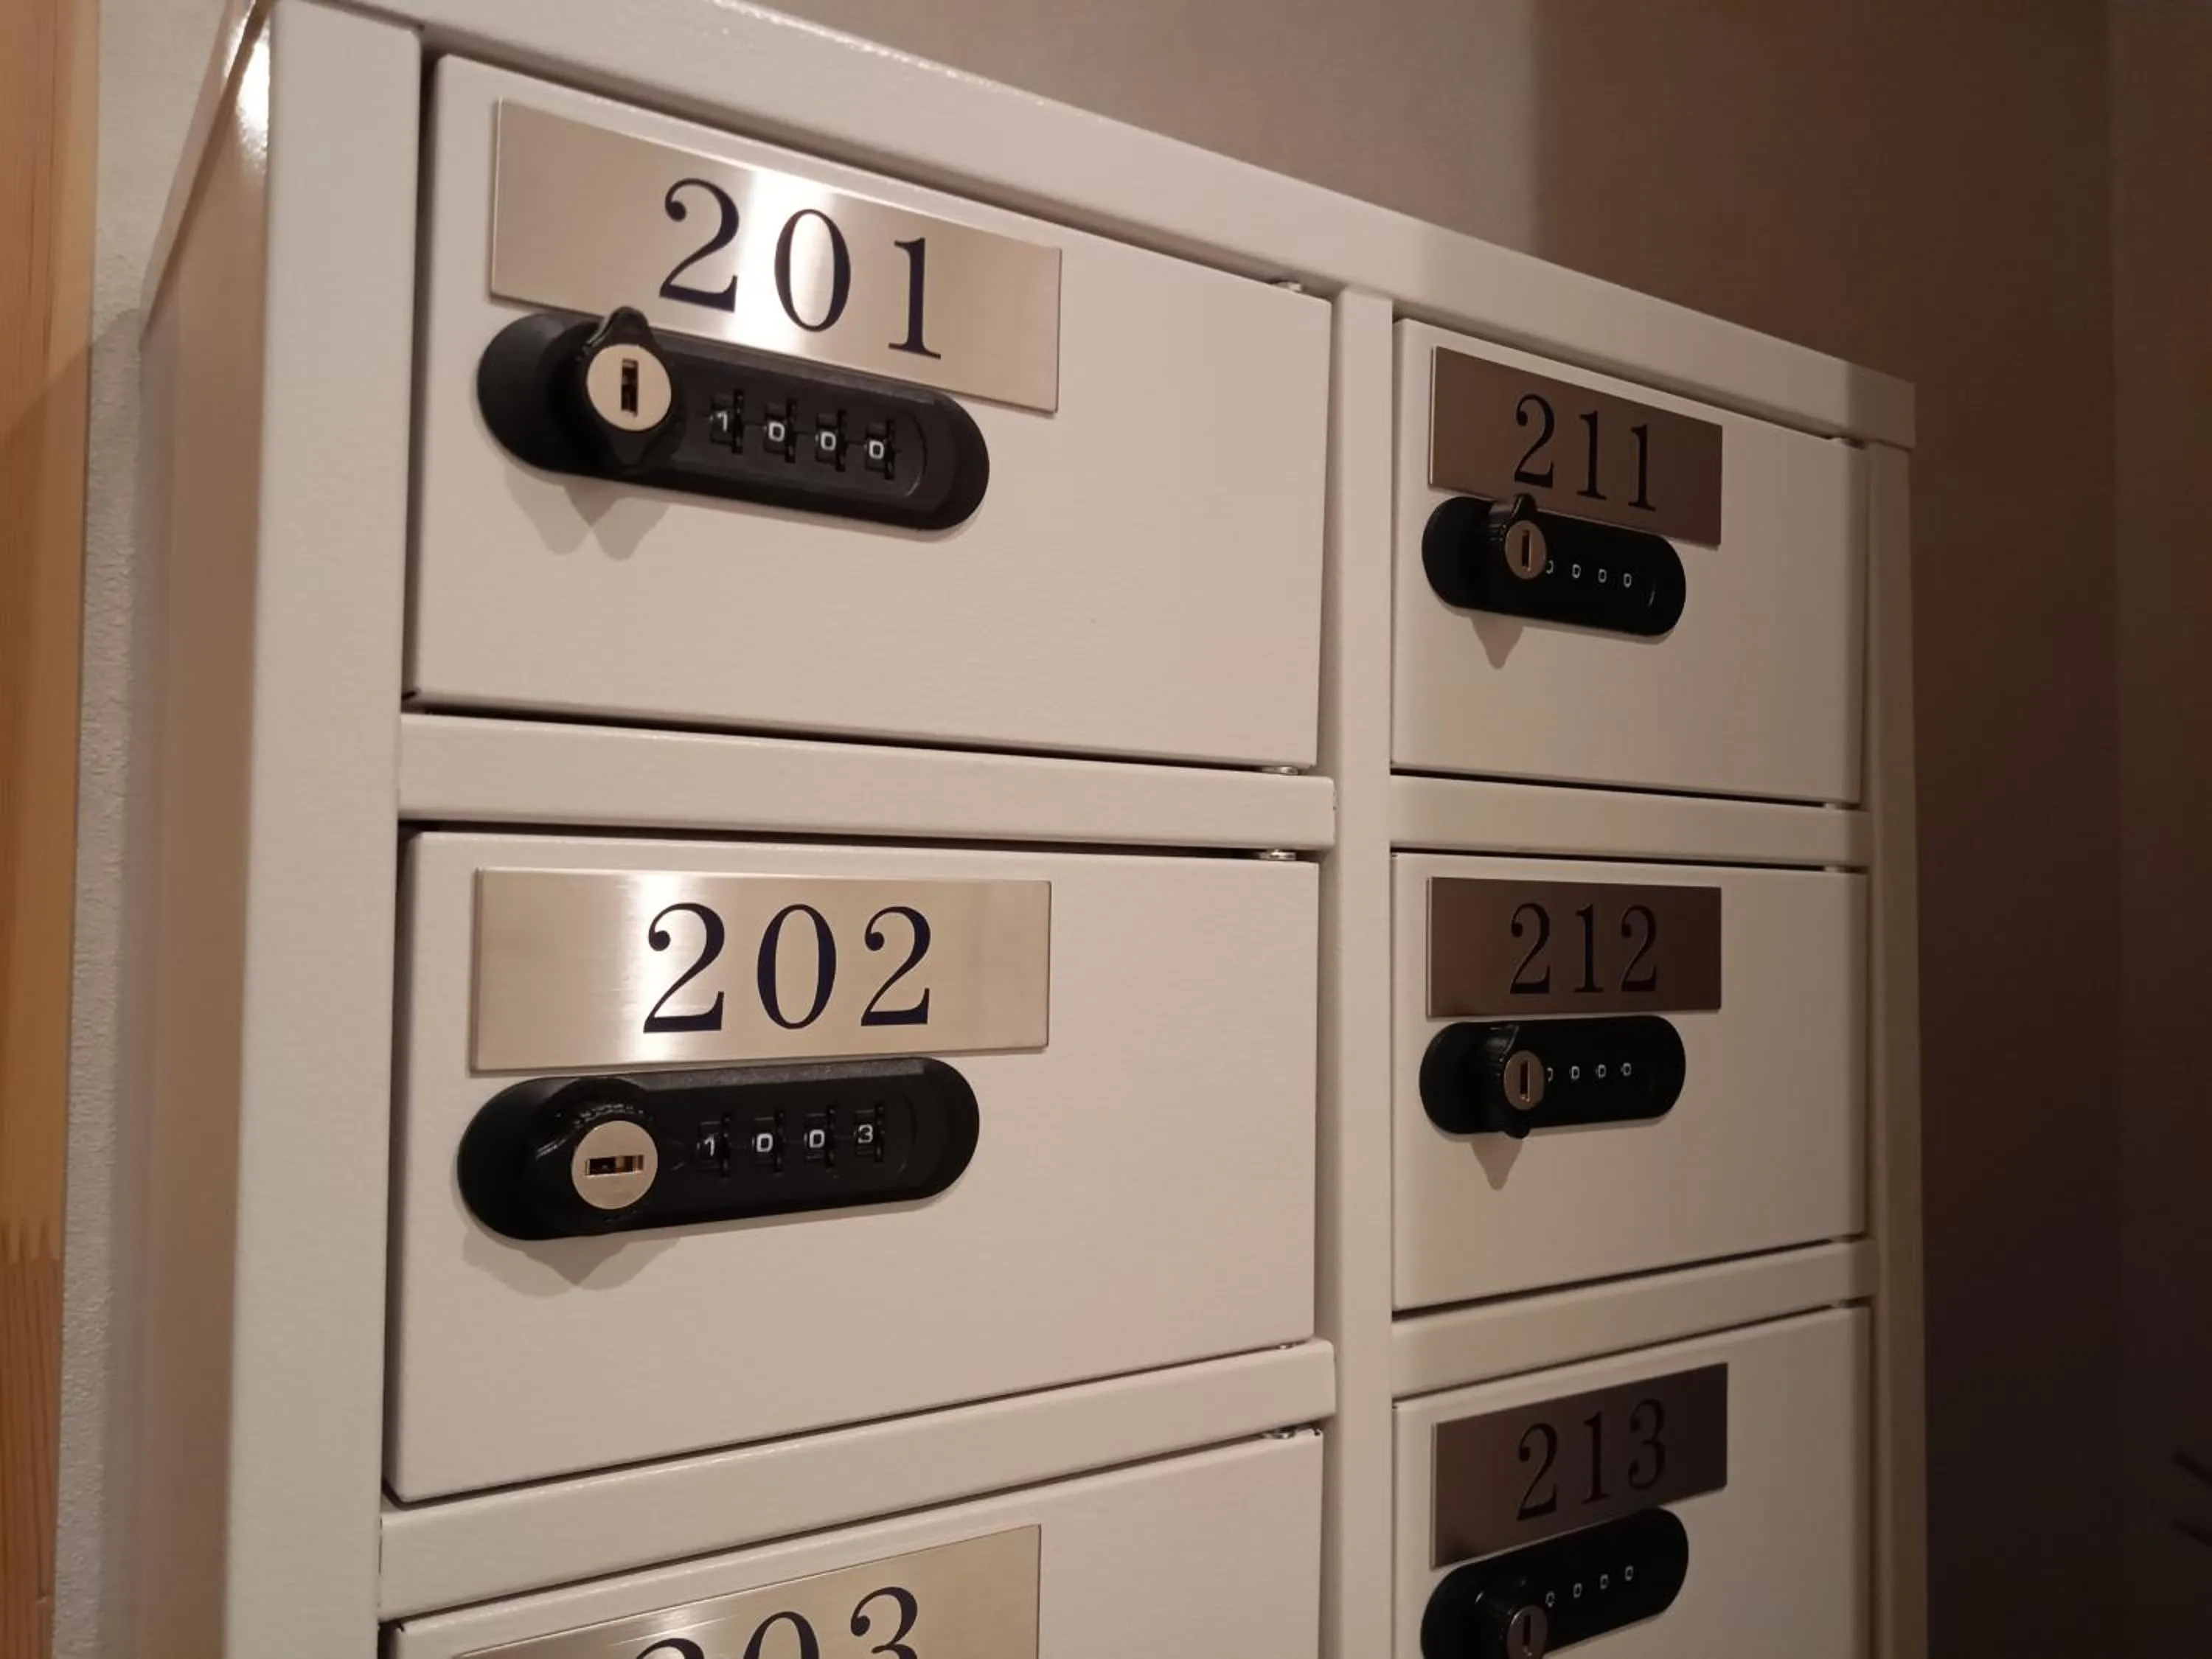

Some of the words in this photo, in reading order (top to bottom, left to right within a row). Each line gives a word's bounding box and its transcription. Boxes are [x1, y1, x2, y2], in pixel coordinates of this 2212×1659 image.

[658, 178, 942, 360] 201
[1514, 394, 1657, 512] 211
[644, 902, 931, 1033] 202
[1509, 902, 1658, 995] 212
[1517, 1398, 1666, 1521] 213
